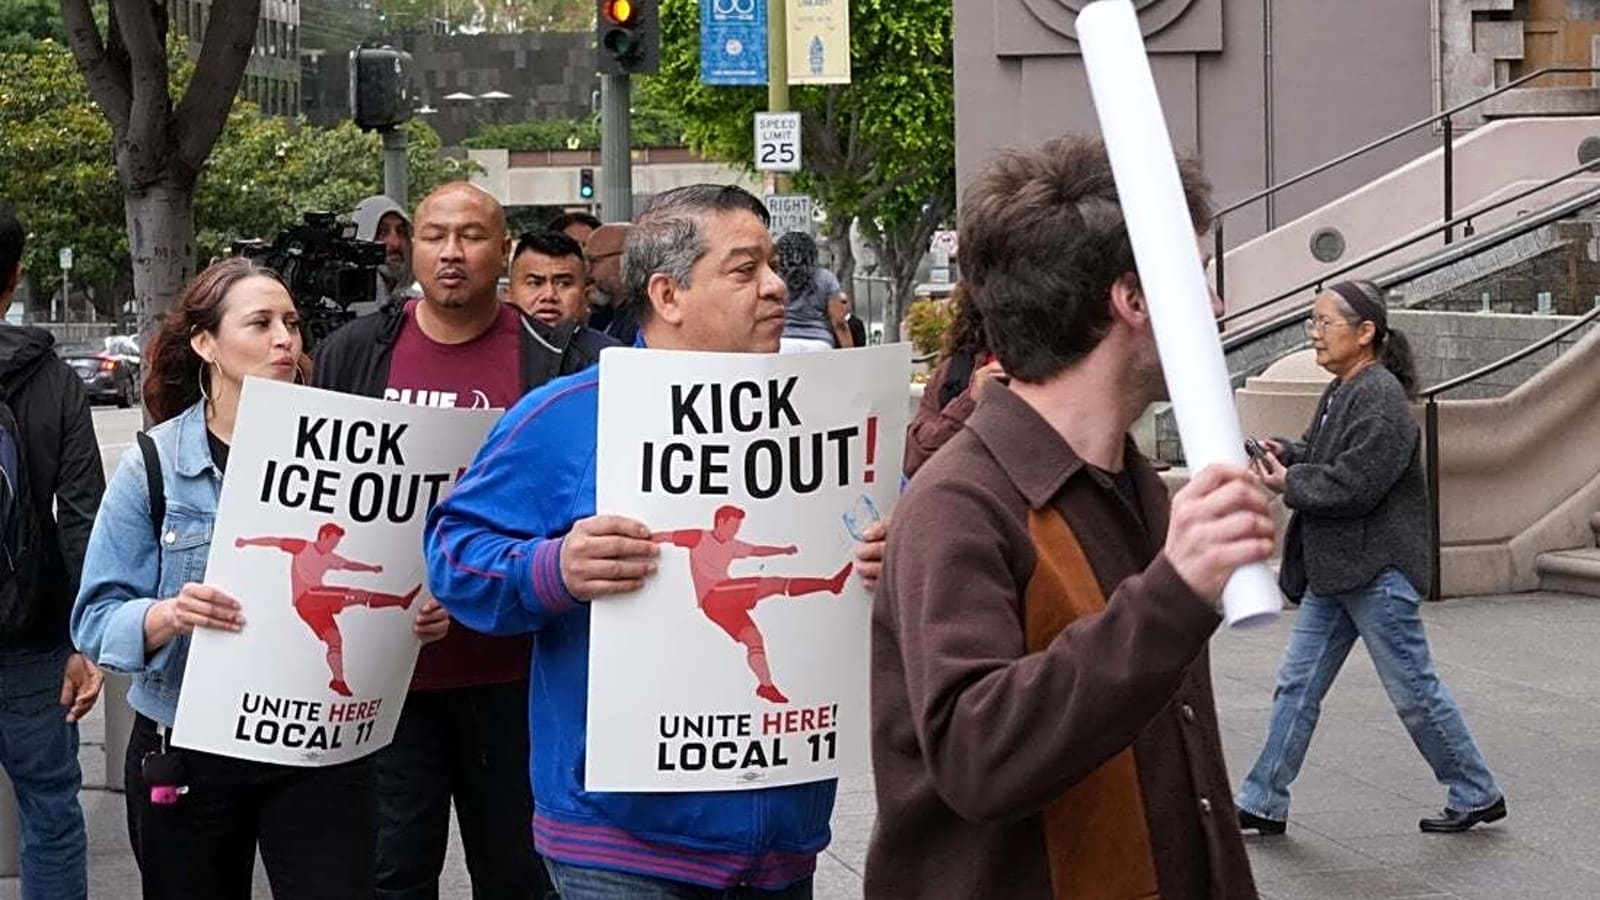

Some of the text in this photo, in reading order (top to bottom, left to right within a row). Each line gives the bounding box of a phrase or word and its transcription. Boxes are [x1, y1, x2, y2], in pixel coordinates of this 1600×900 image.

[760, 119, 796, 129] SPEED
[763, 131, 792, 140] LIMIT
[761, 143, 795, 163] 25
[770, 199, 808, 213] RIGHT
[671, 376, 801, 435] KICK
[295, 416, 409, 466] KICK
[641, 417, 877, 499] ICE OUT!
[260, 460, 467, 524] ICE OUT
[242, 693, 383, 723] UNITE HERE!
[659, 704, 838, 738] UNITE HERE!
[235, 716, 375, 750] LOCAL 11
[658, 731, 837, 771] LOCAL 11
